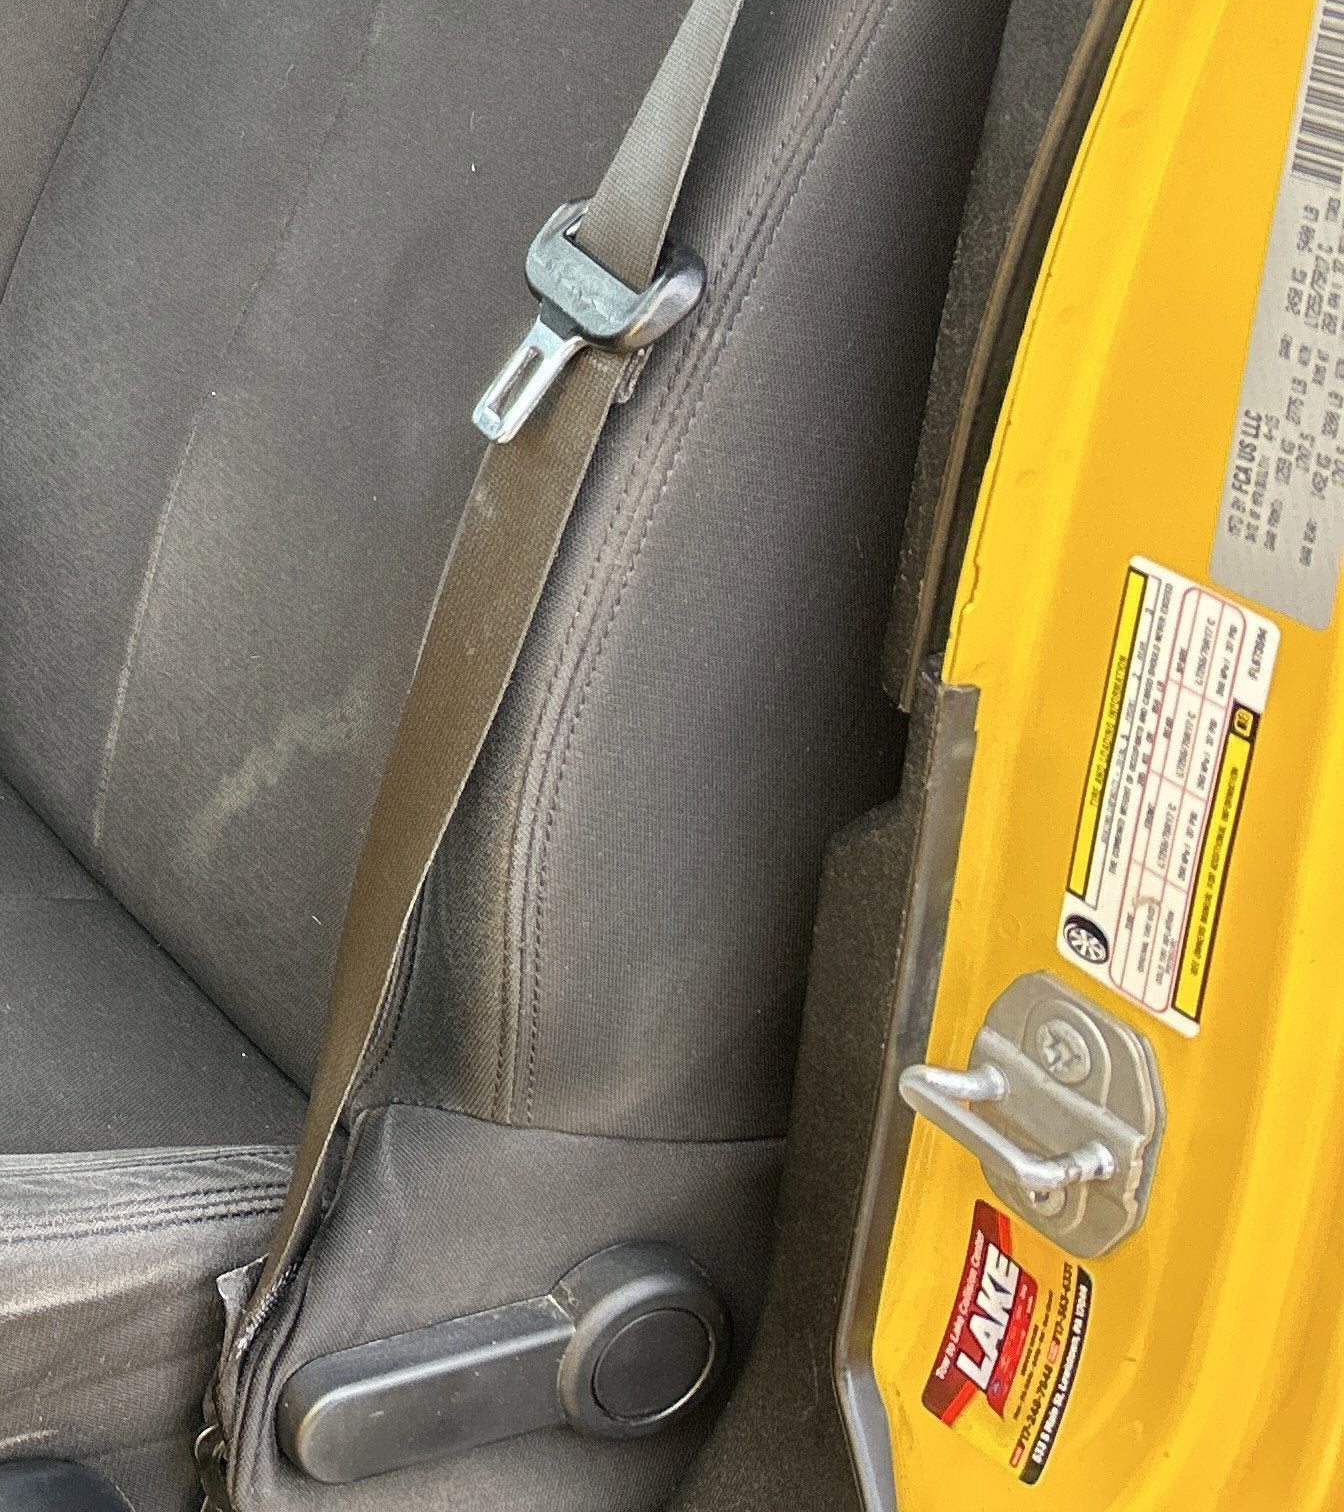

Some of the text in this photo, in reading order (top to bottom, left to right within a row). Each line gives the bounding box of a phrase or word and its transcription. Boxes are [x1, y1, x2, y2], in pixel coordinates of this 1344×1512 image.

[1240, 406, 1262, 440] LLC
[1236, 437, 1257, 464] US
[1230, 460, 1253, 495] FCA
[1107, 653, 1127, 720] INFORMATION
[950, 1314, 964, 1343] Lake
[957, 1268, 977, 1316] Collision
[970, 1229, 986, 1268] Center
[956, 1243, 1020, 1390] LAKE
